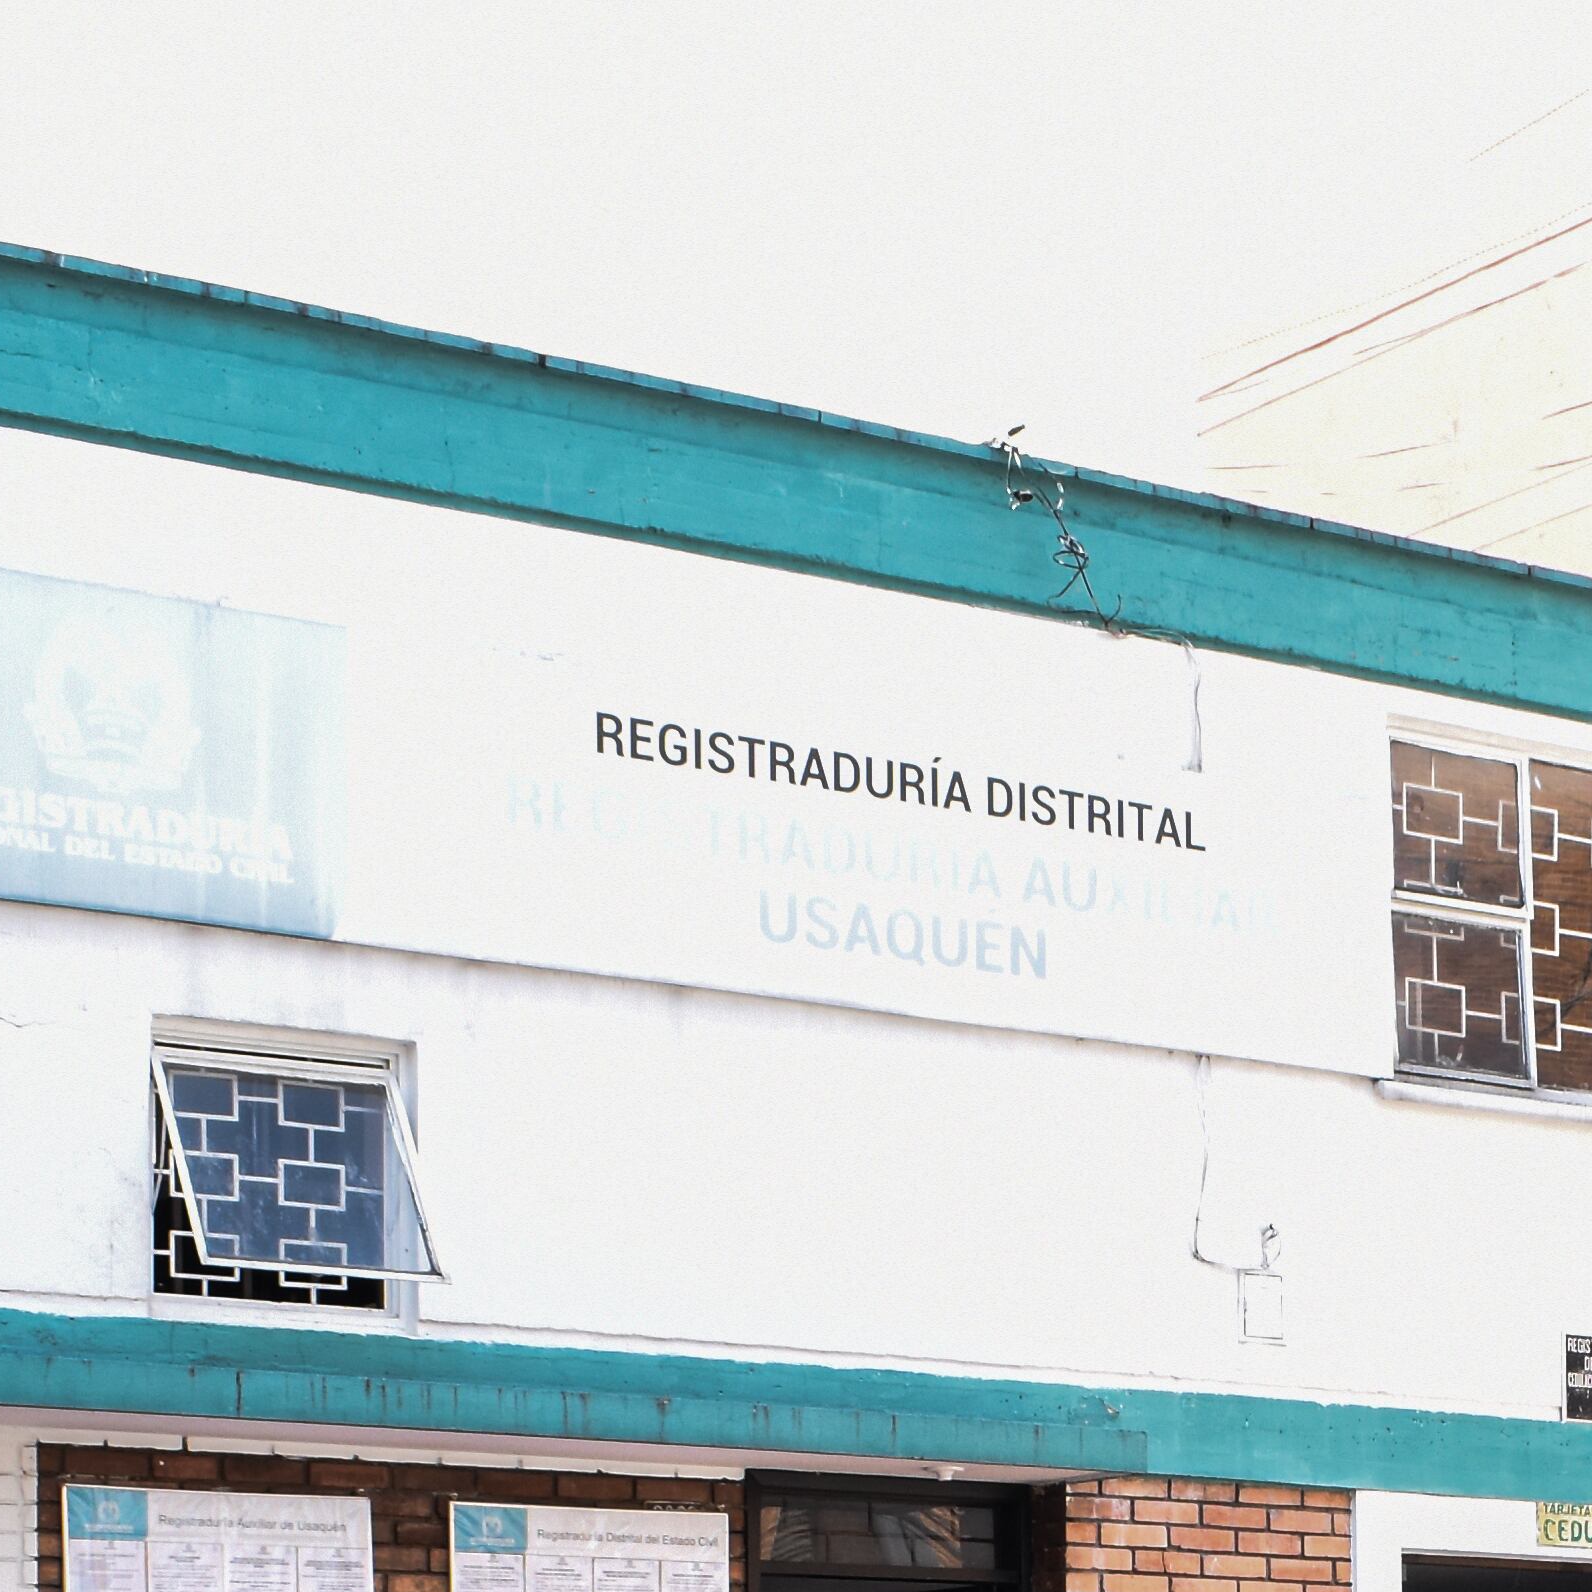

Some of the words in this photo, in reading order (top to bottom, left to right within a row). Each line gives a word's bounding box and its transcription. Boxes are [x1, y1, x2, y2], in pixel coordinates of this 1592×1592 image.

[595, 711, 972, 813] REGISTRADURÍA
[986, 776, 1207, 852] DISTRITAL
[64, 835, 116, 862] DEL
[758, 888, 1048, 981] USAQUÉN
[1543, 1502, 1590, 1517] TARJETA
[280, 1519, 295, 1531] de
[662, 1534, 696, 1547] Estado
[698, 1535, 719, 1548] Civil
